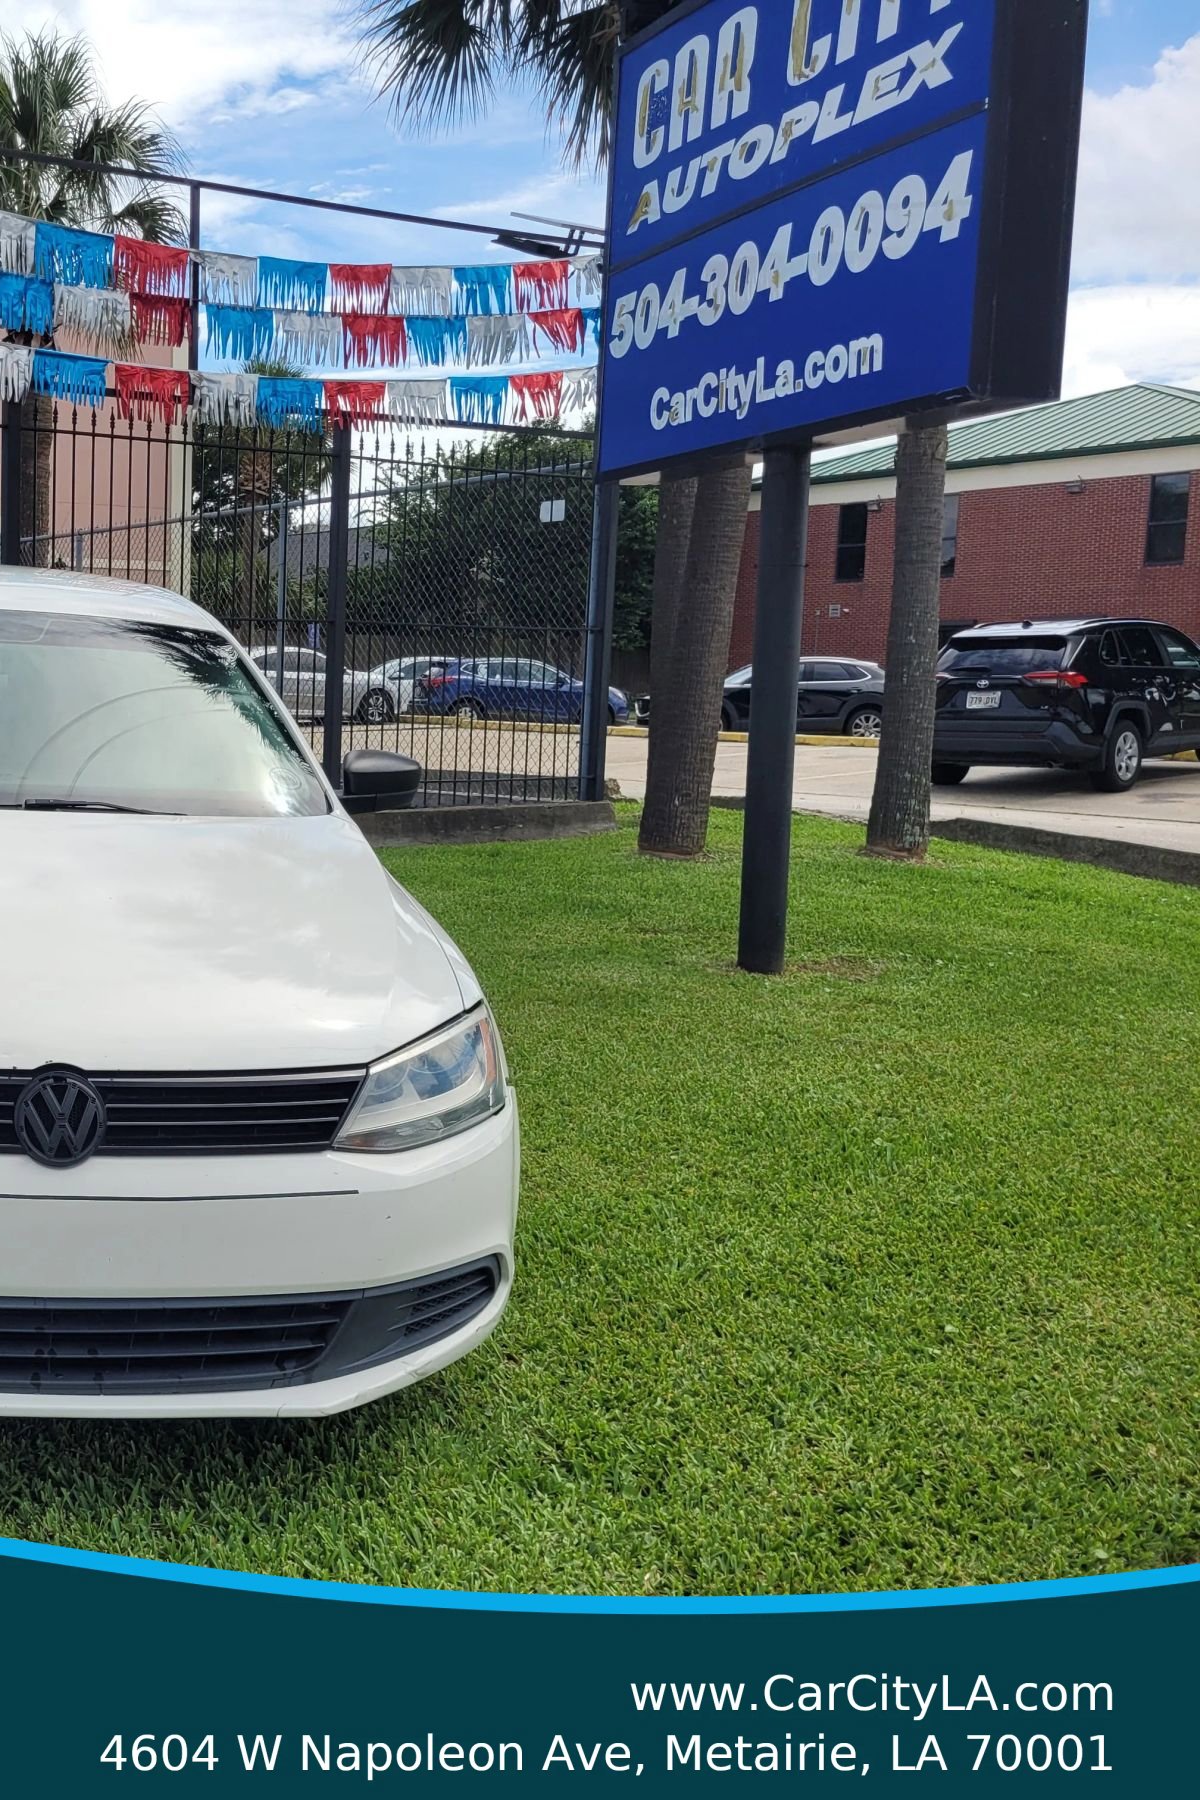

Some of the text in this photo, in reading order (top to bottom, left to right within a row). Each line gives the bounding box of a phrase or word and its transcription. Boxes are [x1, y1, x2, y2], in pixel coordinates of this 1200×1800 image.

[627, 21, 964, 236] AUTOPLEX
[633, 6, 758, 169] CAR
[609, 150, 973, 359] 504-304-0094
[650, 333, 883, 431] CarCityLa.com
